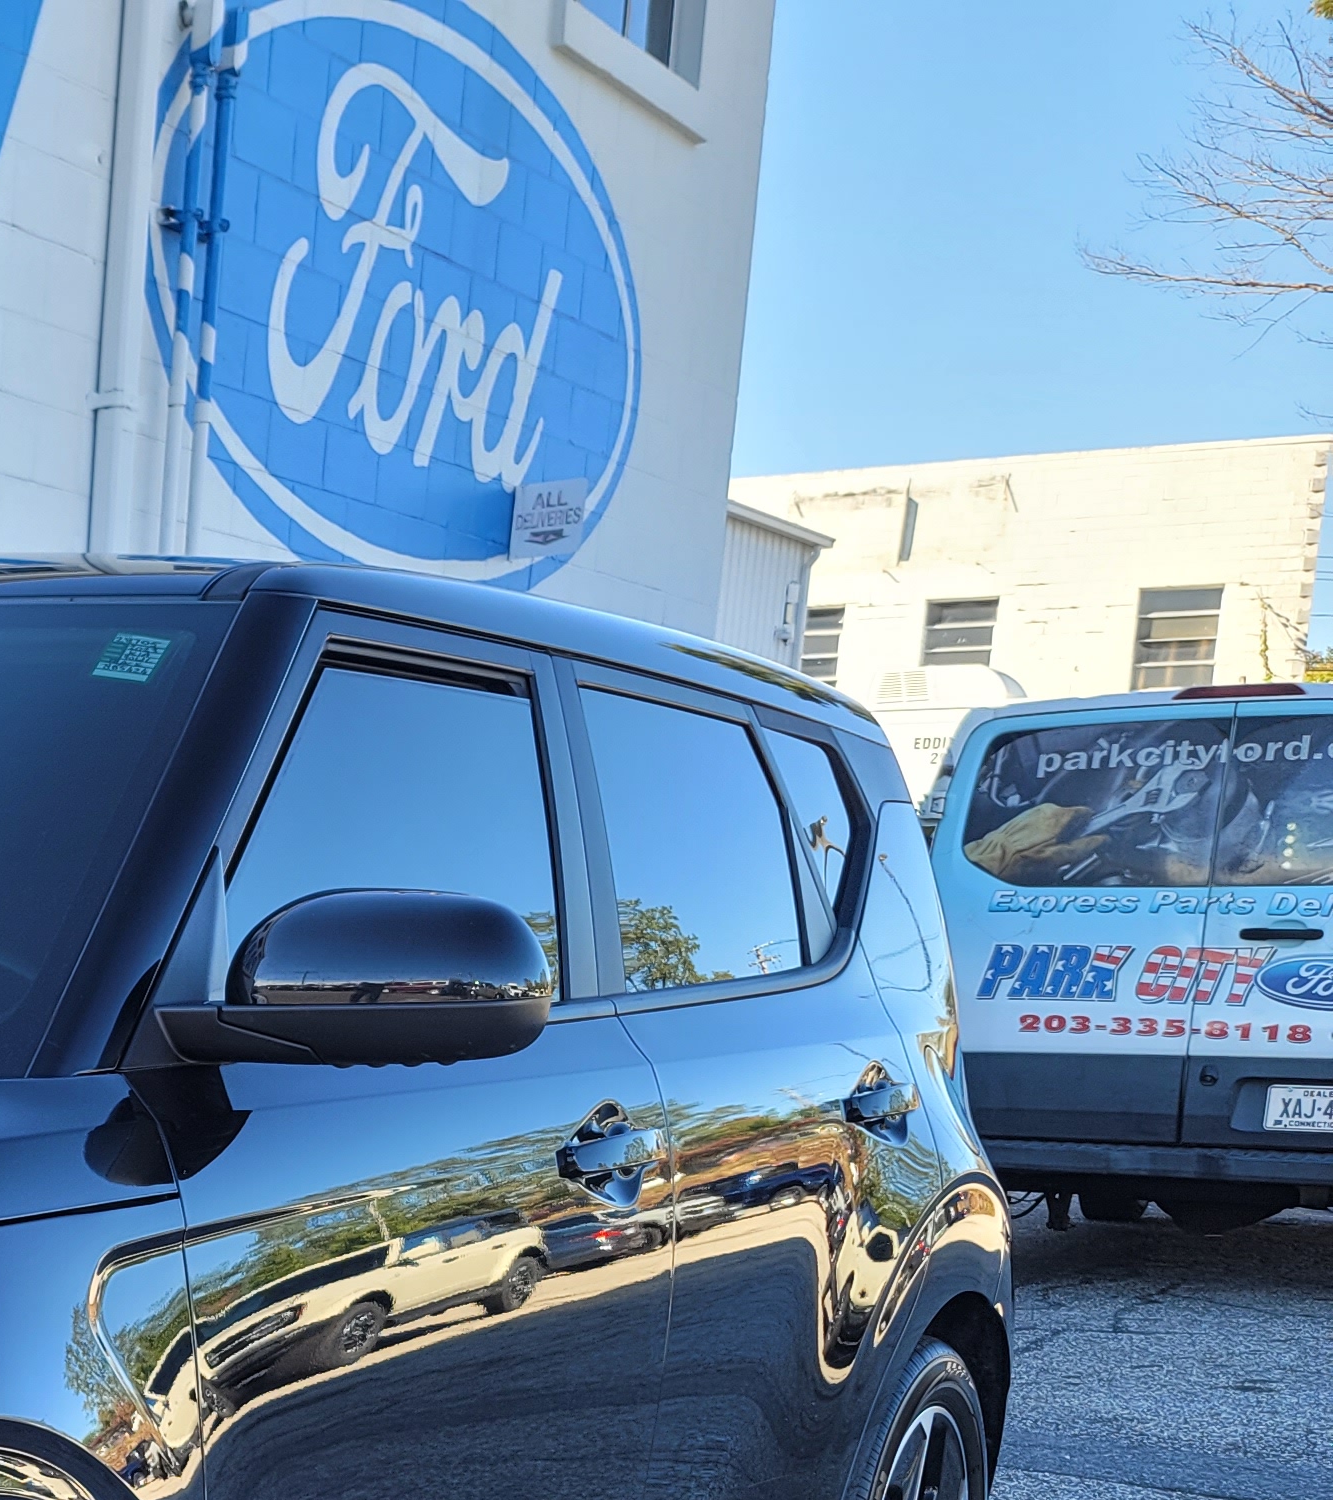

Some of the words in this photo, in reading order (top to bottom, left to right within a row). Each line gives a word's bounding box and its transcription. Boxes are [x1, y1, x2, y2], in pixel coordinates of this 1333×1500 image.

[268, 62, 562, 494] Ford
[531, 489, 568, 511] ALL
[514, 507, 582, 531] DELIVERIES
[913, 736, 955, 750] EDDI
[987, 889, 1139, 918] Express
[1147, 890, 1256, 916] Parts
[976, 943, 1136, 1002] PARK
[1134, 945, 1278, 1007] CITY
[1018, 1014, 1313, 1044] 203-335-8118
